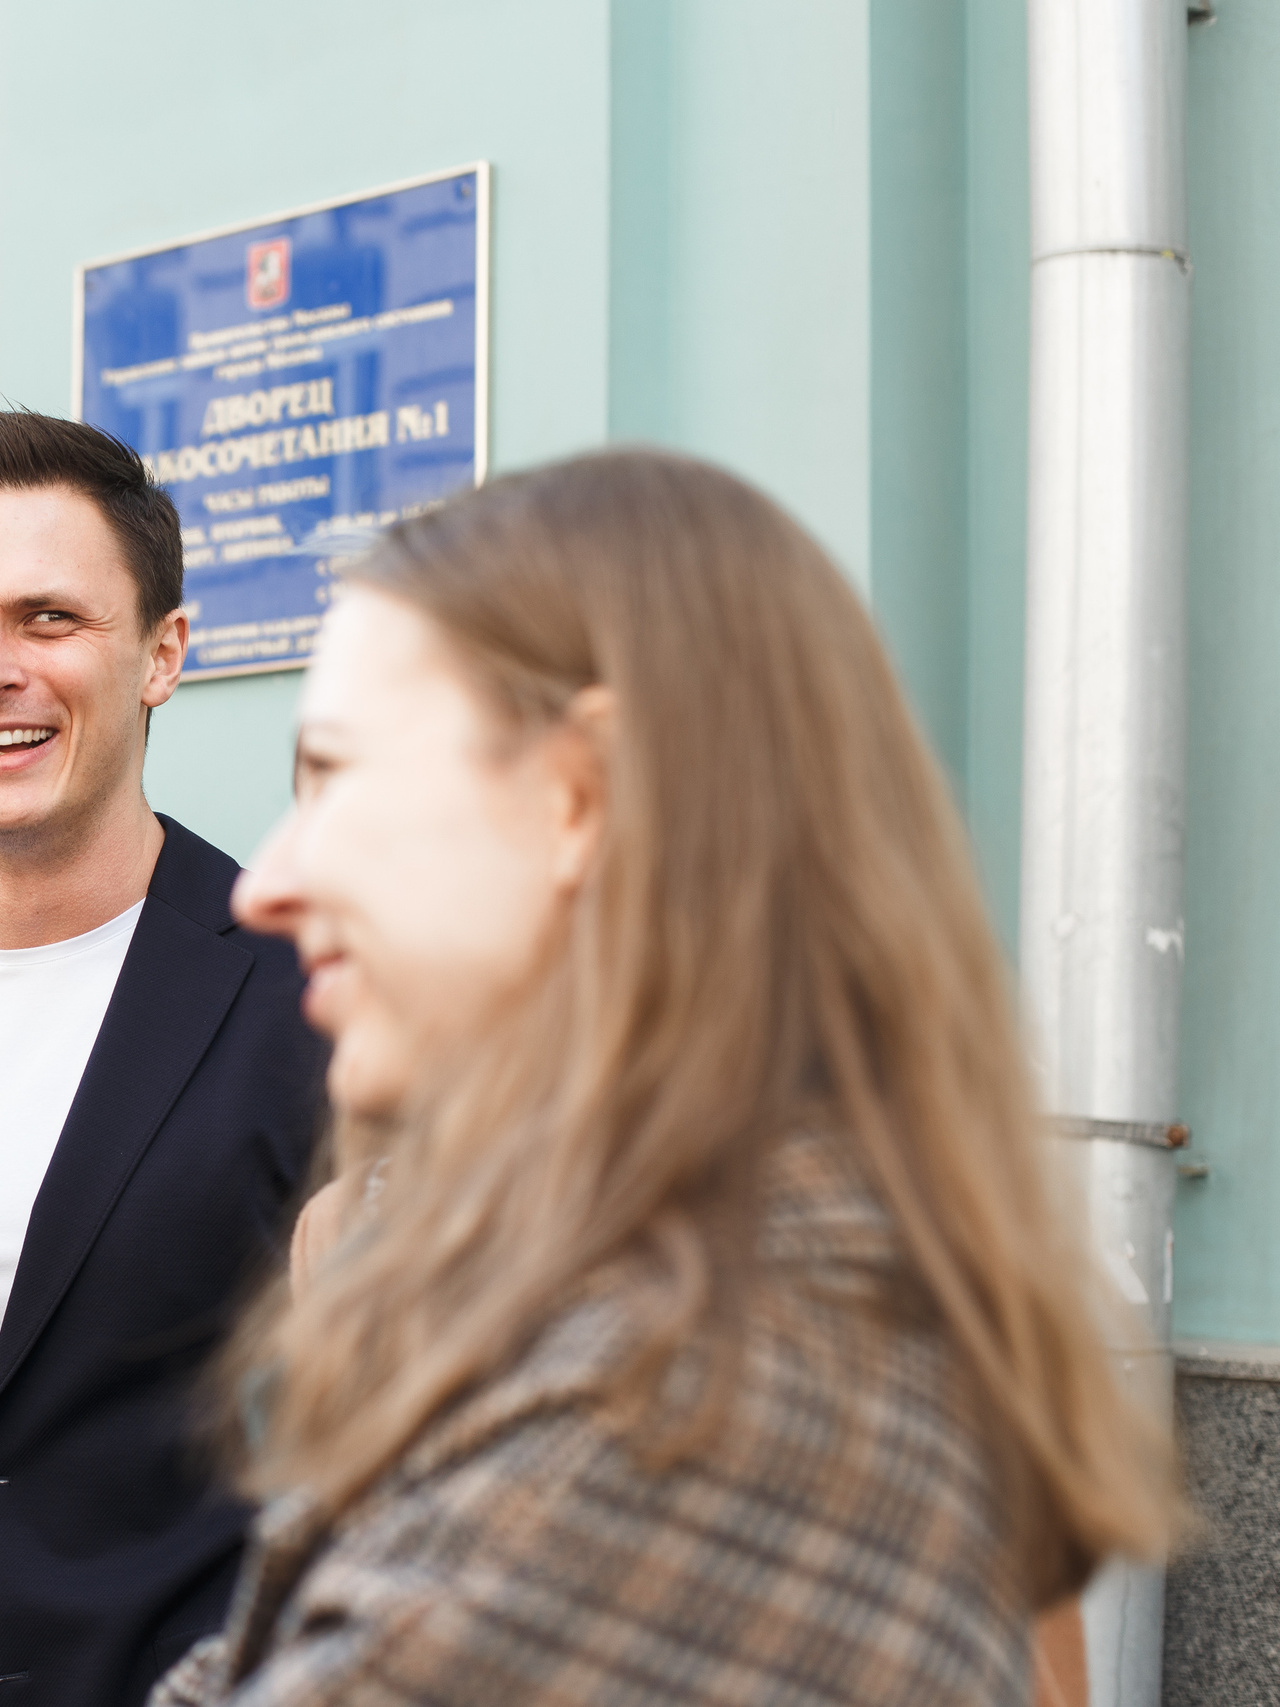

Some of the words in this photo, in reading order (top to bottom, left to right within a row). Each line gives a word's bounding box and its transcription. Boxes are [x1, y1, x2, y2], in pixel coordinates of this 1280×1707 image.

[141, 410, 390, 482] КОСОЧЕТАНИЯ
[396, 401, 449, 442] №1
[201, 377, 335, 437] ДВОРЕЦ
